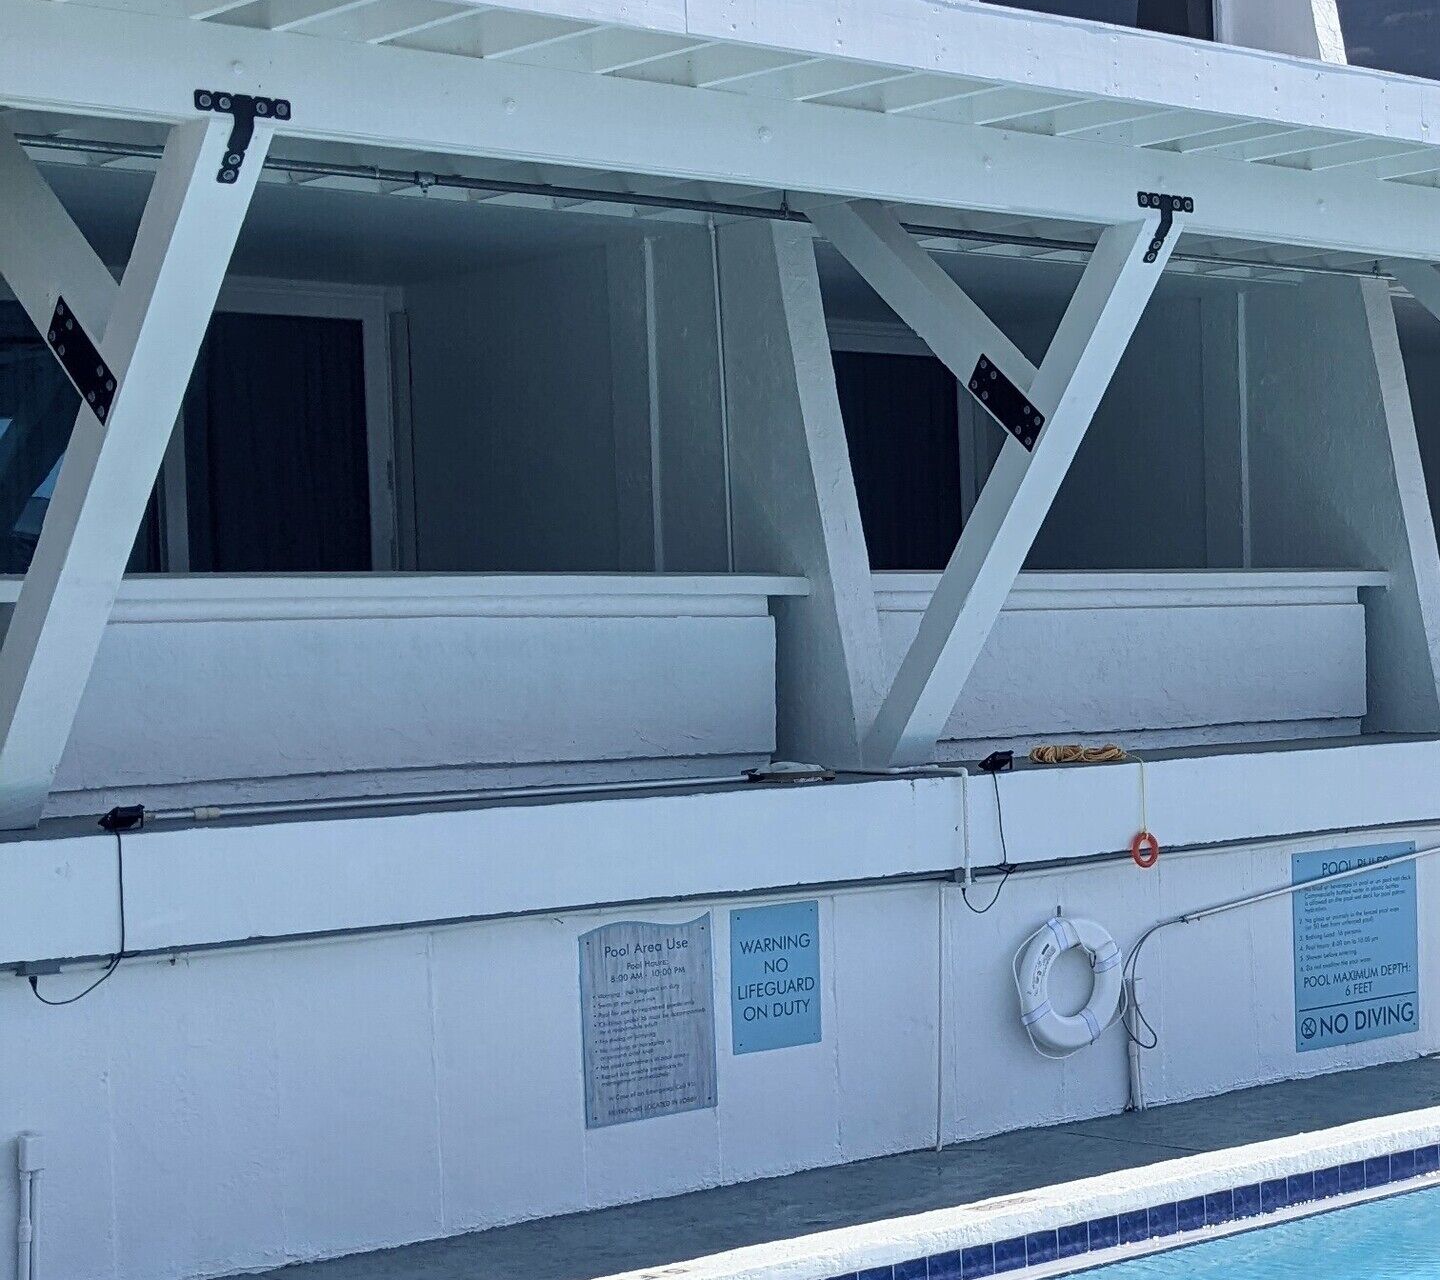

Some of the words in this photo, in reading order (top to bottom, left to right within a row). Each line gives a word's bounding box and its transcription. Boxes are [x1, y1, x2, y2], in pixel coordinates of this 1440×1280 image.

[1322, 860, 1352, 877] POOL
[604, 943, 630, 958] Pool
[634, 942, 662, 954] Area
[667, 937, 689, 950] Use
[740, 933, 811, 955] WARNING
[630, 972, 644, 980] AM
[651, 967, 672, 978] 10:00
[674, 966, 686, 974] PM
[764, 957, 788, 974] NO
[1303, 974, 1331, 989] POOL
[1333, 967, 1379, 985] MAXIMUM
[1381, 962, 1412, 976] DEPTH:
[737, 976, 815, 1000] LIFEGUARD
[1345, 984, 1351, 997] 6
[1354, 980, 1373, 995] FEET
[743, 1004, 768, 1021] ON
[773, 999, 811, 1018] DUTY
[1320, 1012, 1349, 1037] NO
[1355, 1001, 1414, 1031] DIVING
